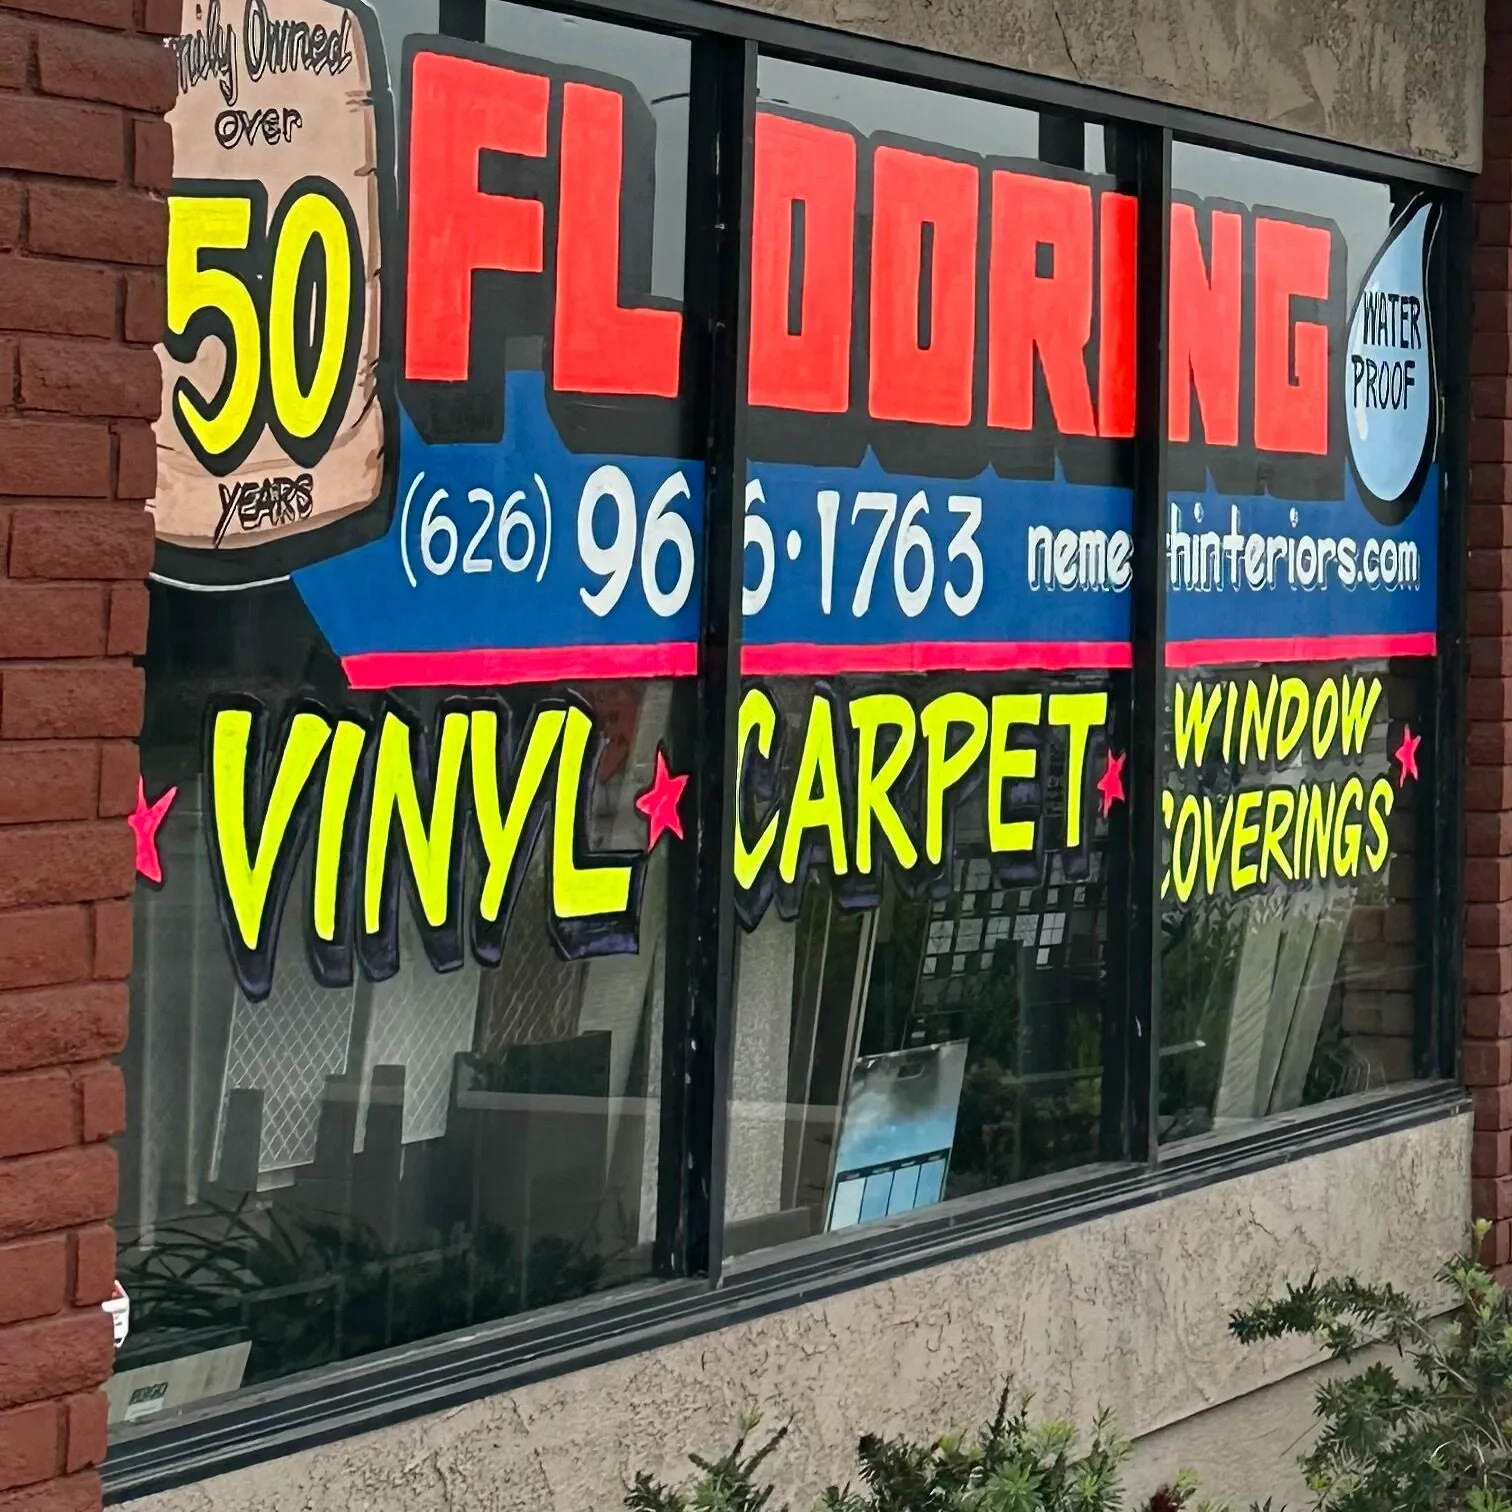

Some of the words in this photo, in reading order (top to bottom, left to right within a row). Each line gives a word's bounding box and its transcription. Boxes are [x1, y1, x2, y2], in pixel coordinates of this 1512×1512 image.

[214, 106, 303, 150] over
[405, 50, 1329, 455] FLOORING
[166, 192, 352, 456] 50
[1362, 290, 1422, 350] WATER
[1350, 354, 1416, 411] PROOF
[212, 472, 314, 550] YEARS
[401, 471, 553, 588] (626)
[1026, 501, 1422, 593] nemehinteriors.com
[1174, 673, 1383, 770] WINDOW
[212, 709, 632, 951] VINYL
[733, 688, 1108, 889] CARPET
